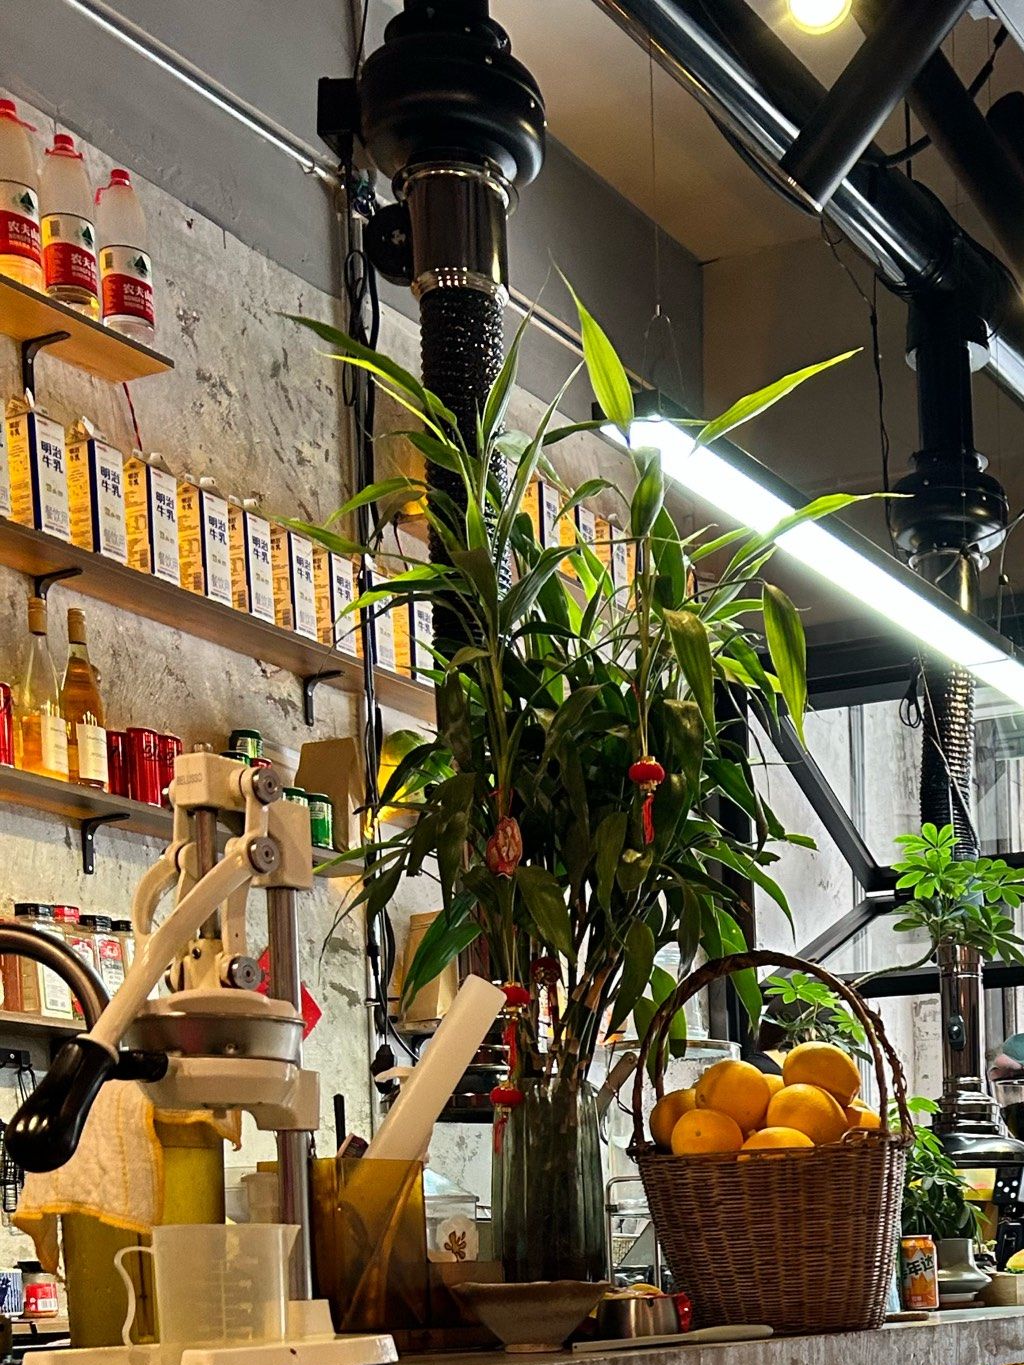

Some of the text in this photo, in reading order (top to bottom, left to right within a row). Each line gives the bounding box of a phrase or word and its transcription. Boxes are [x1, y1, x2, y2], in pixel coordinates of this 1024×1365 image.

[41, 441, 62, 460] 明治
[42, 455, 63, 474] 牛乳
[100, 466, 120, 485] 明治
[101, 480, 121, 498] 牛乳
[155, 491, 175, 510] 明治
[156, 505, 176, 523] 牛乳
[208, 515, 227, 532] 明治
[209, 529, 227, 545] 牛乳
[252, 536, 269, 552] 明治
[253, 549, 270, 565] 牛乳
[296, 555, 311, 571] 明治
[296, 567, 312, 583] 牛乳
